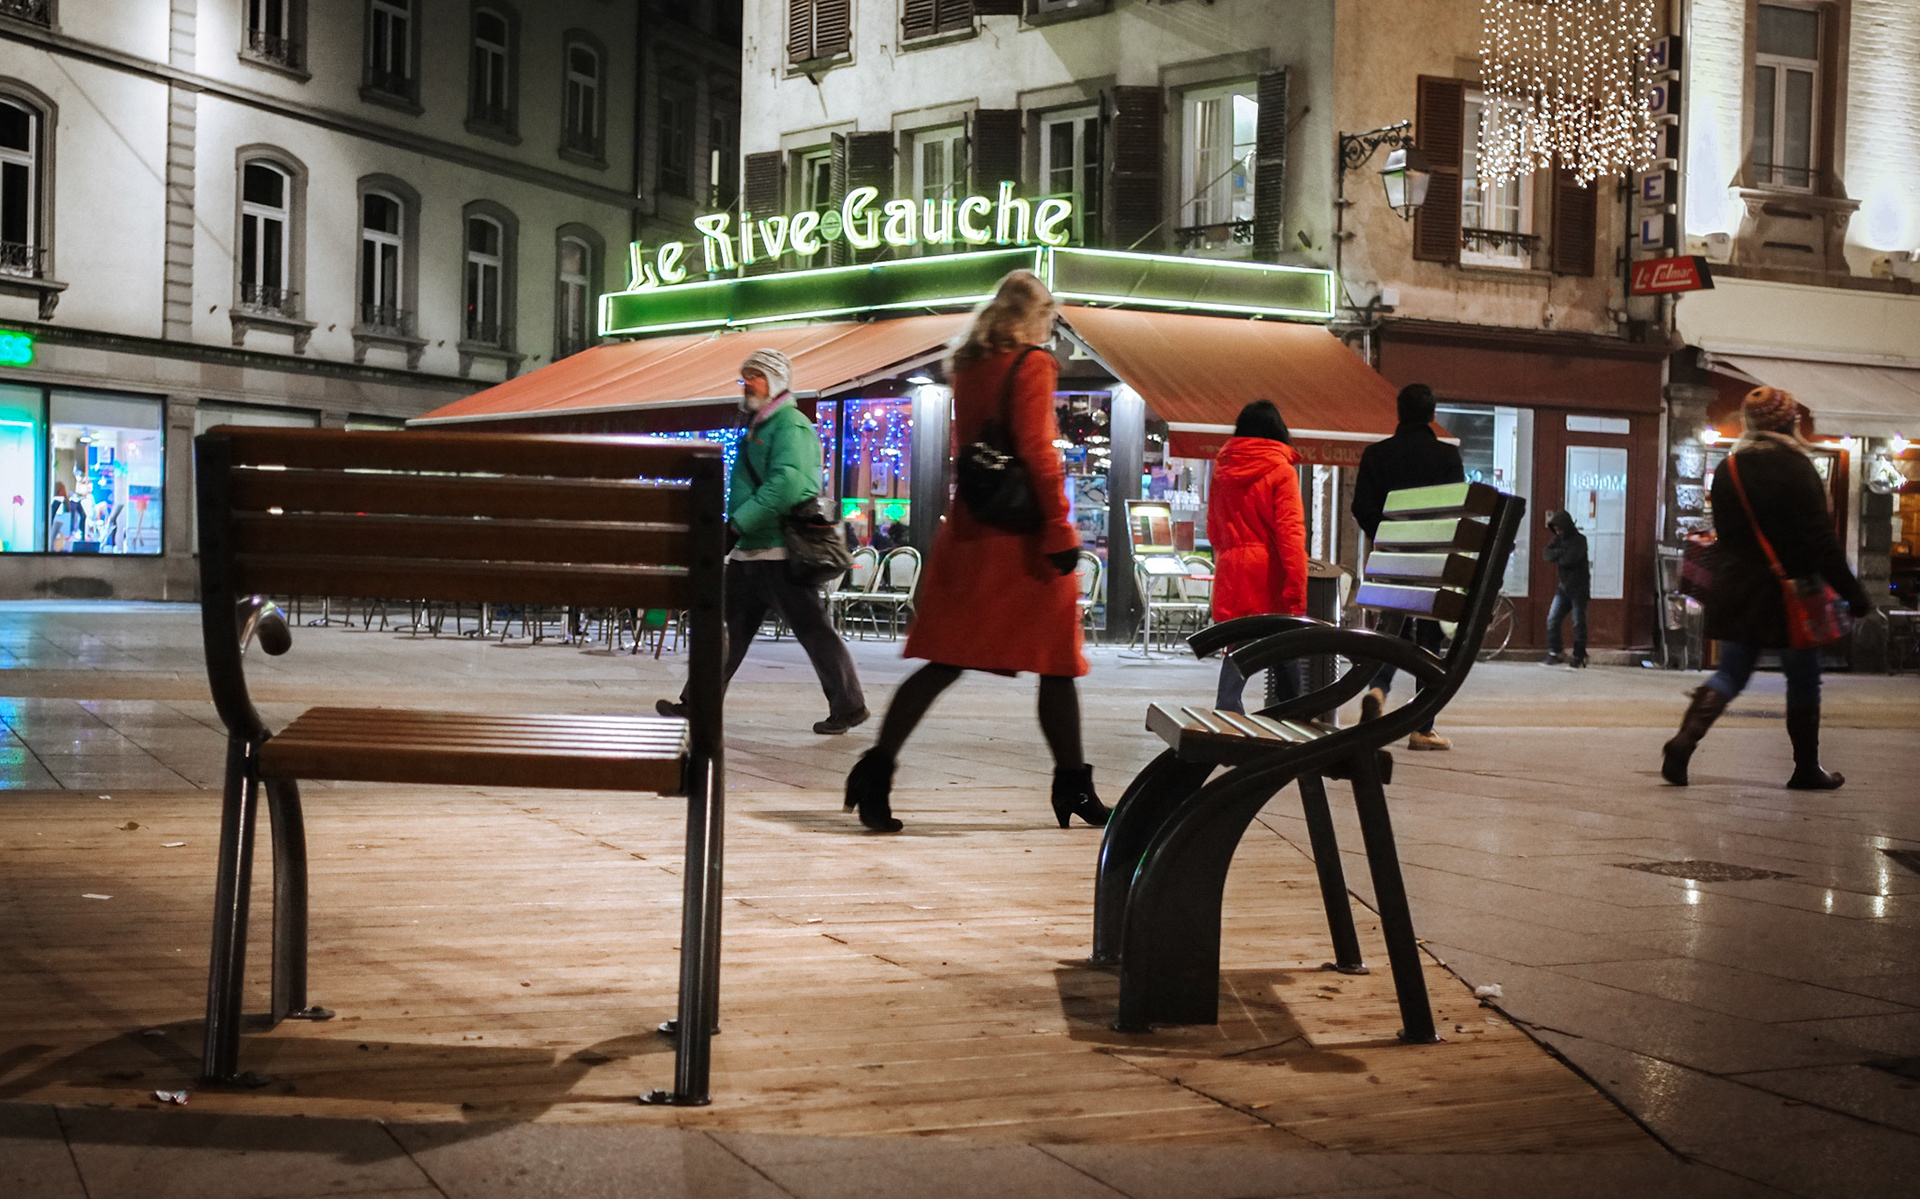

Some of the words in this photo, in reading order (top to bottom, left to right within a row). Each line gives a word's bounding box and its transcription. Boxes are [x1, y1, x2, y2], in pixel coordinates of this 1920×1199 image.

[627, 240, 686, 292] Le
[694, 210, 823, 274] Rive
[842, 180, 1074, 250] Gauche
[1634, 267, 1651, 290] Le
[1651, 262, 1694, 288] Colmar
